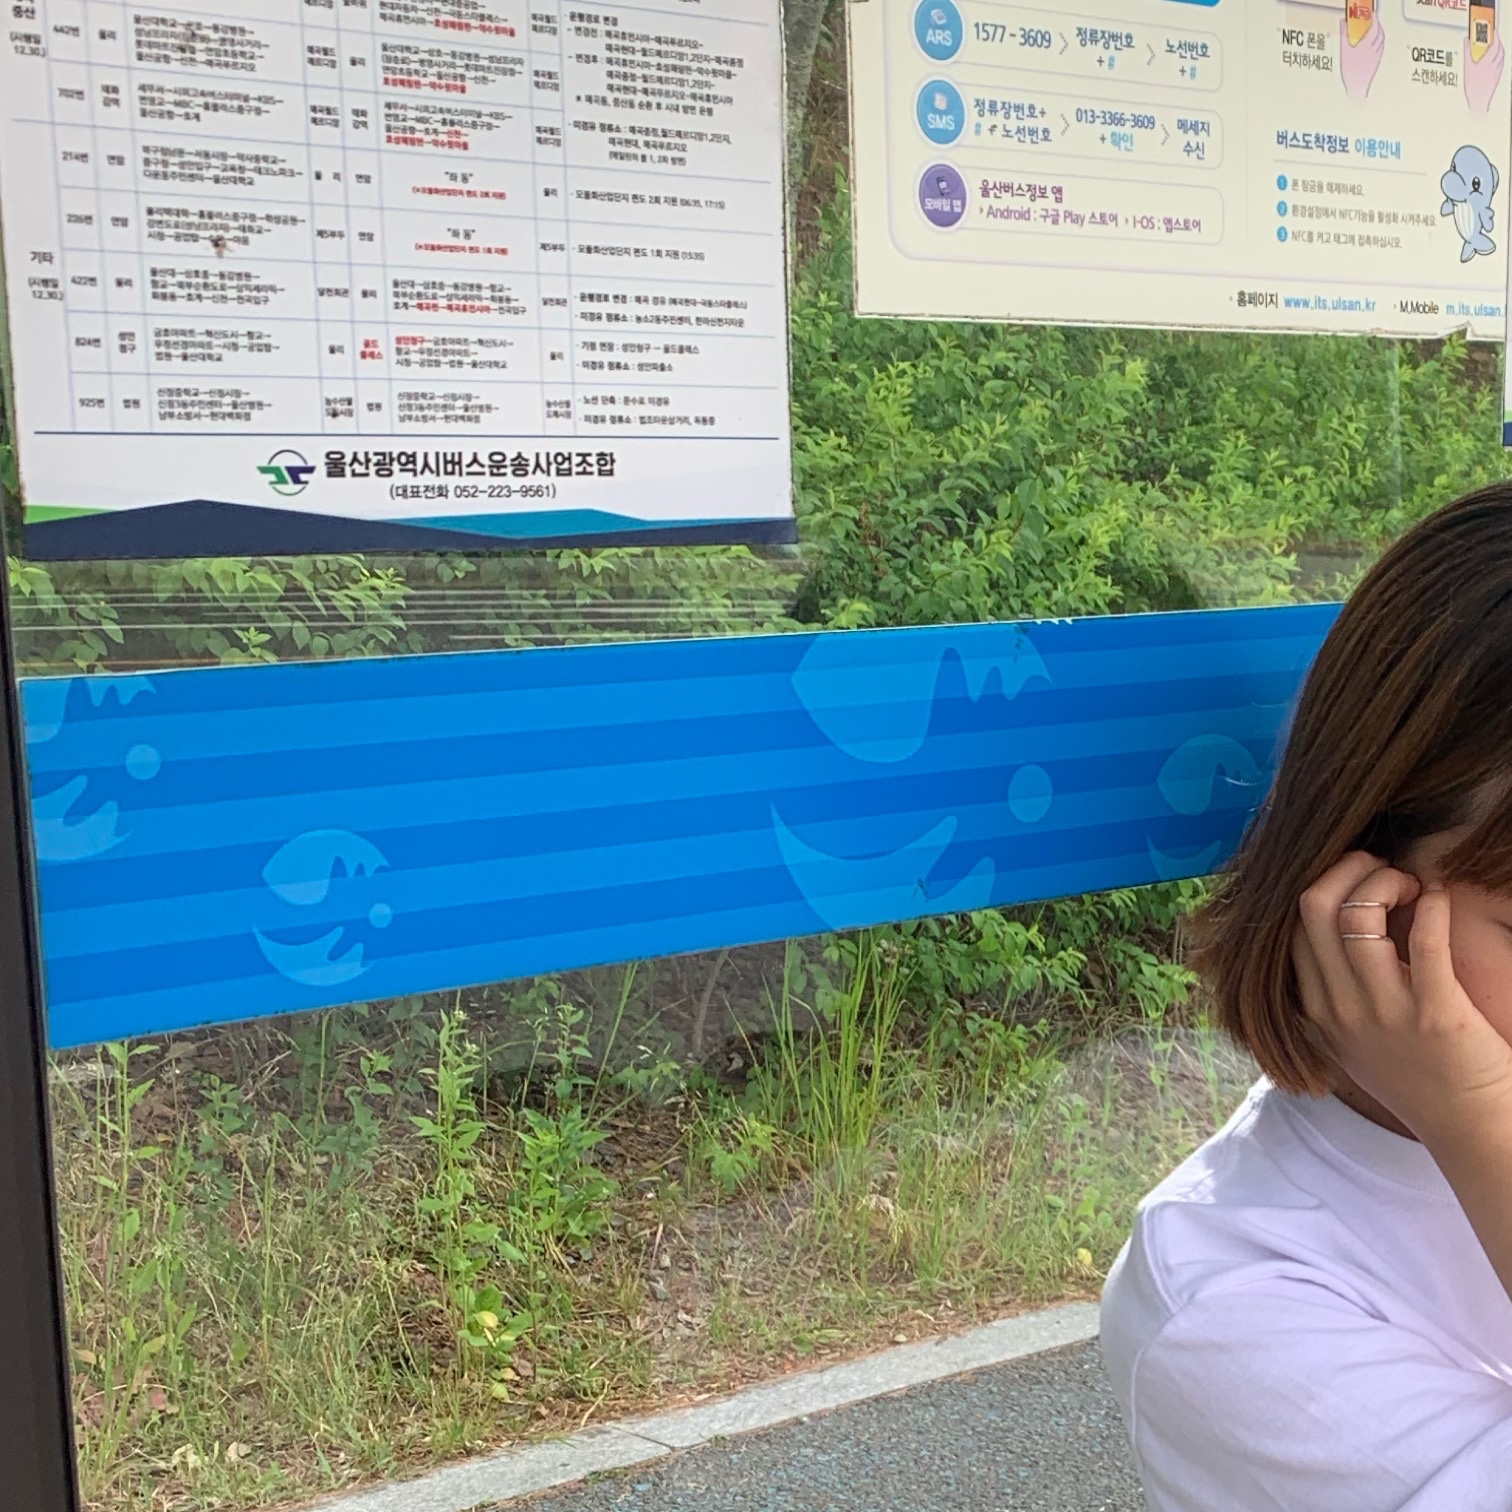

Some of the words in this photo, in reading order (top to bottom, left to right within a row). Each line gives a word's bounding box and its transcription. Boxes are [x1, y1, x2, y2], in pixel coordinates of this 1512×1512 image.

[11, 6, 36, 19] 중산
[926, 28, 953, 47] ARS
[1076, 26, 1135, 51] 정류장번호
[1165, 38, 1211, 61] 노선번호
[1282, 50, 1333, 72] 터치하세요!
[1411, 66, 1458, 88] 스캔하세요!
[927, 113, 955, 132] SMS
[1075, 107, 1156, 131] 013-3366-3609
[1177, 117, 1211, 138] 메세지
[1001, 122, 1053, 144] 노선번호
[1110, 130, 1134, 153] 확인
[1182, 140, 1206, 161] 수신
[1276, 130, 1350, 154] 버스도착정보
[1354, 137, 1402, 160] 이용안내
[979, 179, 1048, 203] 울산버스정보
[1051, 184, 1064, 204] 앱
[923, 197, 951, 213] 모바일
[952, 199, 962, 214] 앱
[986, 205, 1031, 222] Android
[1038, 208, 1061, 225] 구글
[1063, 209, 1086, 227] Play
[1088, 211, 1118, 228] 스토어
[1162, 216, 1202, 235] 앱스토어
[30, 251, 54, 265] 기타
[1237, 290, 1279, 309] 홈페이지
[1283, 294, 1376, 314] www.its.ulsan.kr
[1446, 303, 1507, 318] m.its.ulsan.
[606, 313, 629, 323] 정류소
[607, 361, 631, 372] 정류소
[609, 415, 632, 426] 정류소
[324, 450, 616, 477] 울산광역시버스운송사업조합
[389, 483, 449, 500] (대표전화
[454, 484, 556, 499] 052-223-9561)
